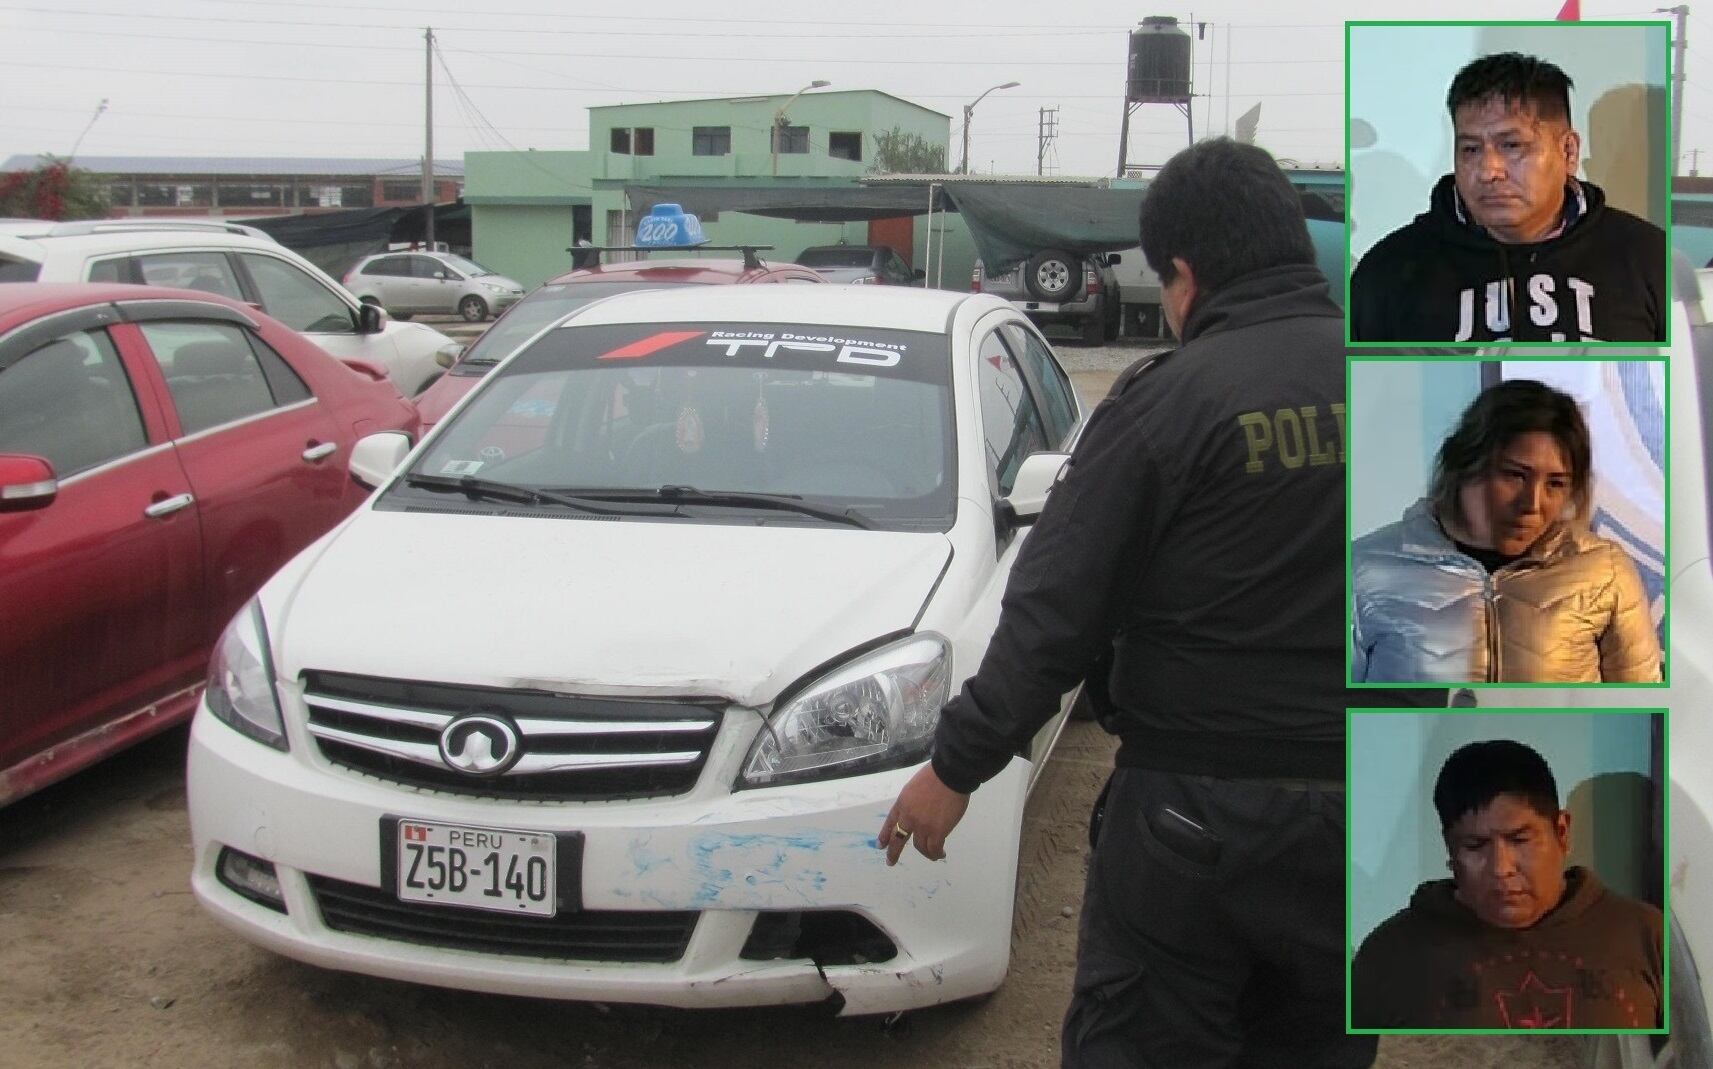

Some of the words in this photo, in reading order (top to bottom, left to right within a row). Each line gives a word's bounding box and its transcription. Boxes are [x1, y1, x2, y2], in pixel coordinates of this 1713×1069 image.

[641, 223, 678, 242] 200
[1455, 273, 1594, 342] JUST
[711, 331, 775, 340] Racing
[781, 333, 907, 351] Development
[449, 830, 502, 849] PERU
[406, 843, 547, 902] Z5B-140
